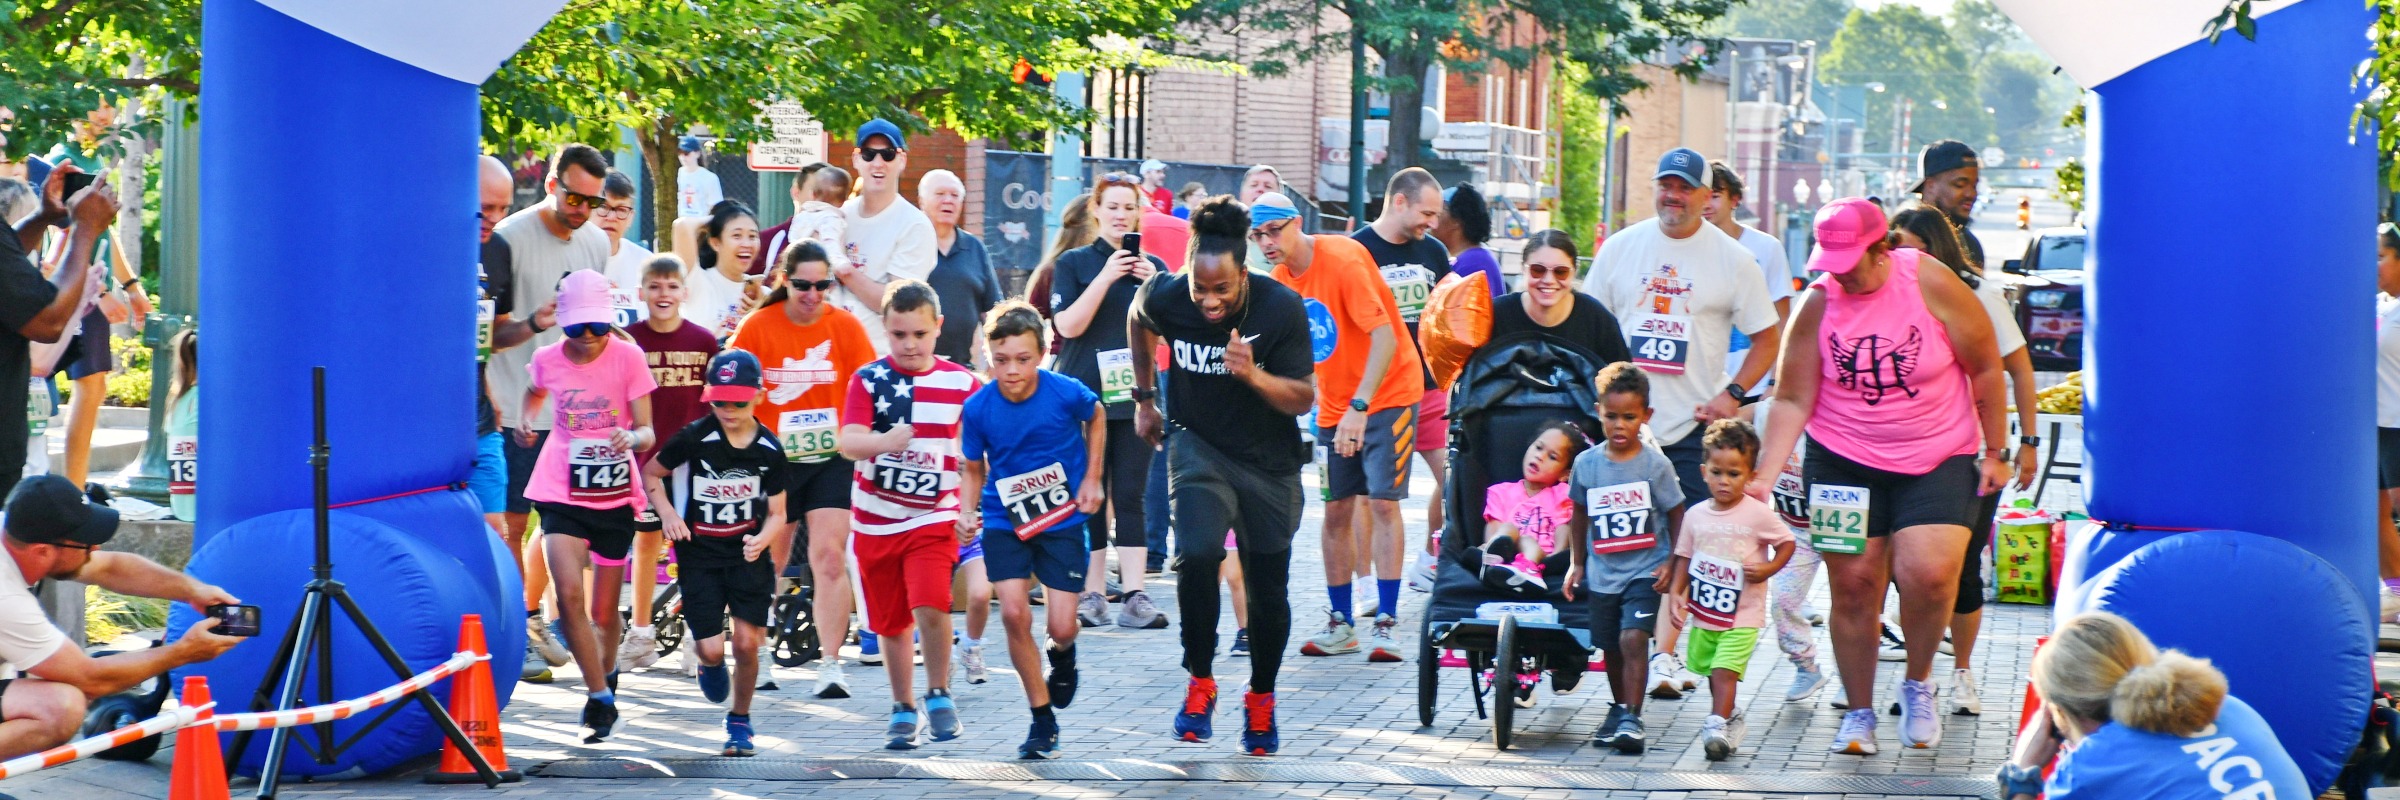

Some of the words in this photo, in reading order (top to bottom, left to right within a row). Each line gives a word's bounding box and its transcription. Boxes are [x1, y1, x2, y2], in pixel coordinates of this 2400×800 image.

[760, 147, 815, 155] CENTENNIAL
[772, 156, 800, 164] PLAZA
[1174, 339, 1211, 374] OLY
[1639, 337, 1677, 361] 49
[1106, 368, 1133, 387] 46
[785, 430, 834, 454] 436
[170, 461, 198, 482] 13
[573, 462, 630, 489] 142
[879, 467, 939, 497] 152
[698, 500, 753, 524] 141
[1011, 484, 1070, 525] 116
[1777, 494, 1811, 517] 11
[1594, 509, 1649, 539] 137
[1812, 508, 1863, 534] 442
[1690, 579, 1738, 613] 138
